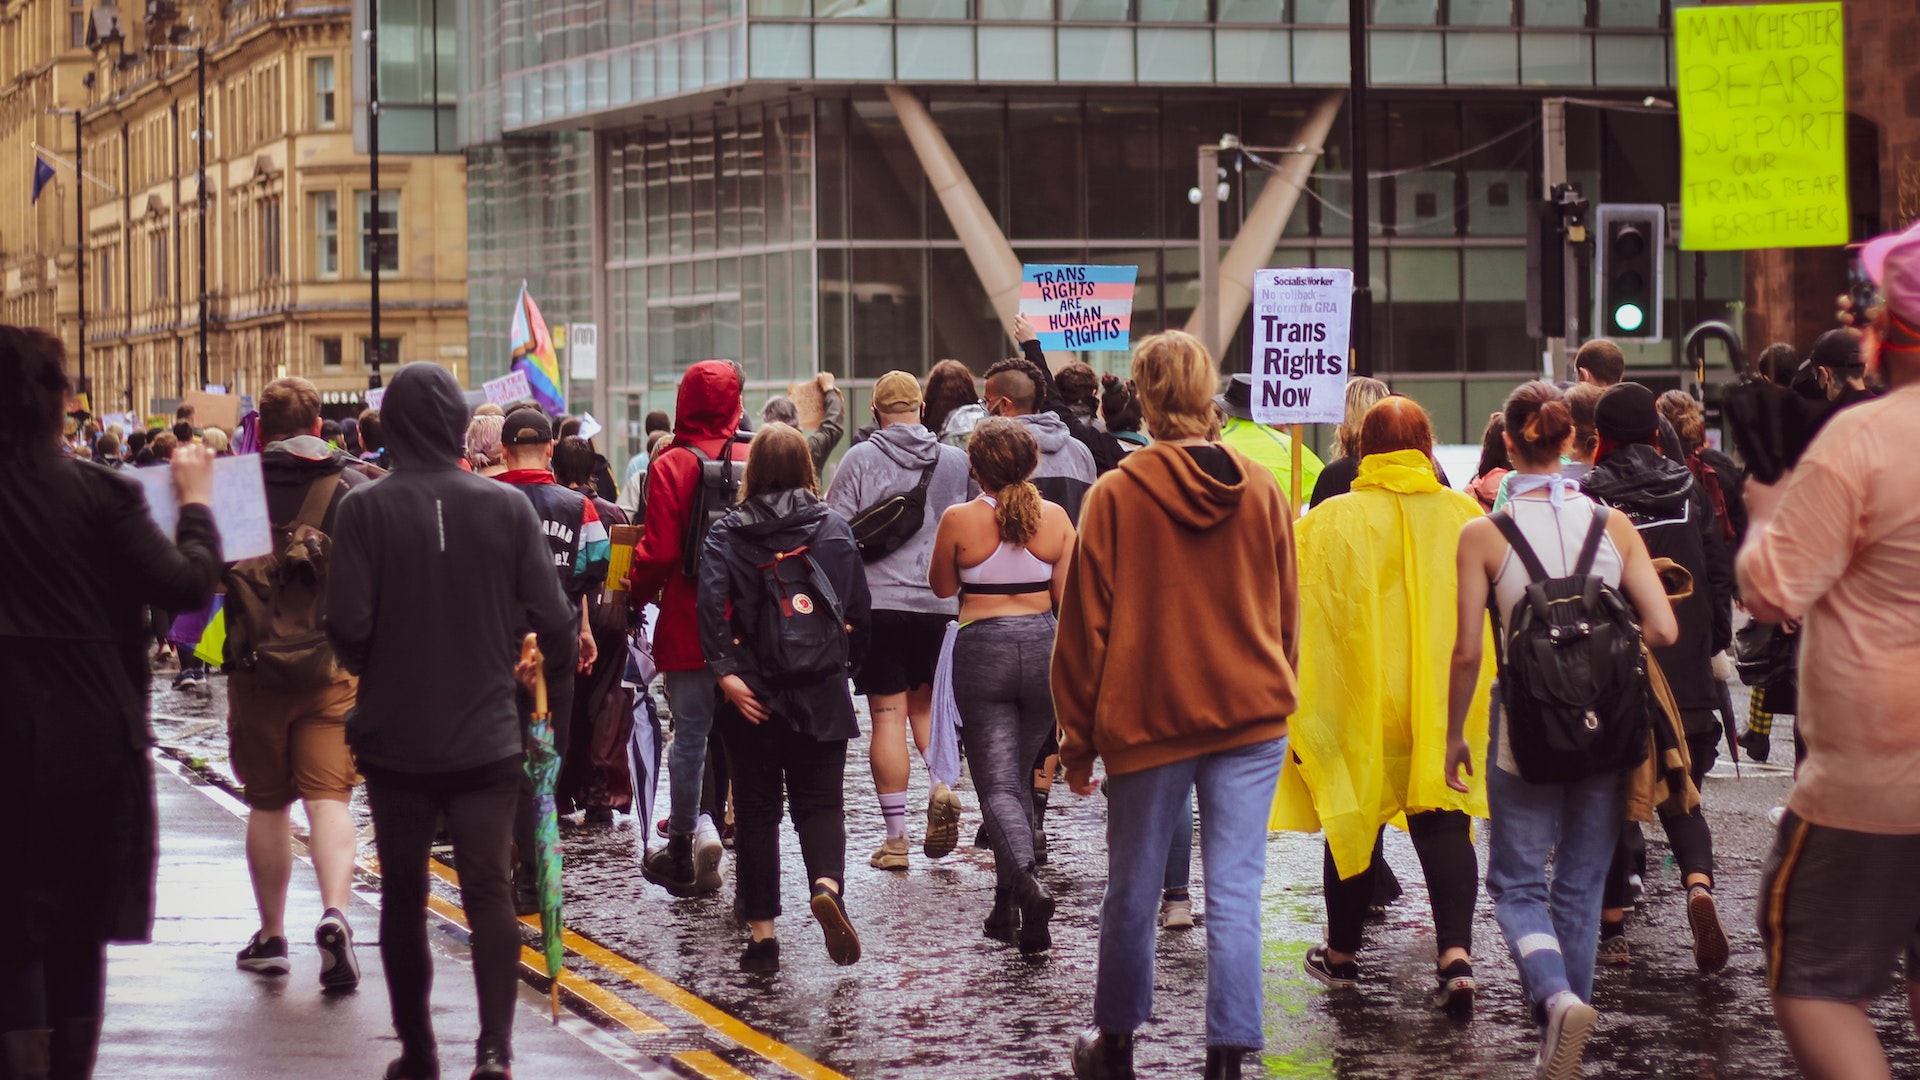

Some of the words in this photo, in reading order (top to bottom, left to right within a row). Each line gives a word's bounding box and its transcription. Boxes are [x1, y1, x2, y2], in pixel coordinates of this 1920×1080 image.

[1687, 8, 1840, 56] MANCHESTER
[1685, 55, 1840, 113] BEARS
[1690, 111, 1843, 156] SUPPORT
[1732, 152, 1777, 176] OUR
[1687, 178, 1773, 208] TRANS
[1782, 174, 1841, 198] BEAR
[1711, 204, 1840, 242] BROTHERS
[1033, 267, 1086, 288] TRANS
[1042, 281, 1095, 302] RIGHTS
[1060, 297, 1082, 312] ARE
[1262, 288, 1276, 300] No
[1281, 288, 1316, 300] rollback
[1049, 305, 1101, 330] HUMAN
[1261, 302, 1297, 313] reform
[1300, 302, 1313, 313] the
[1315, 302, 1337, 313] GRA
[1064, 318, 1120, 348] RIGHTS
[1261, 315, 1326, 342] Trans
[1264, 347, 1342, 380] Rights
[1261, 380, 1312, 407] Now
